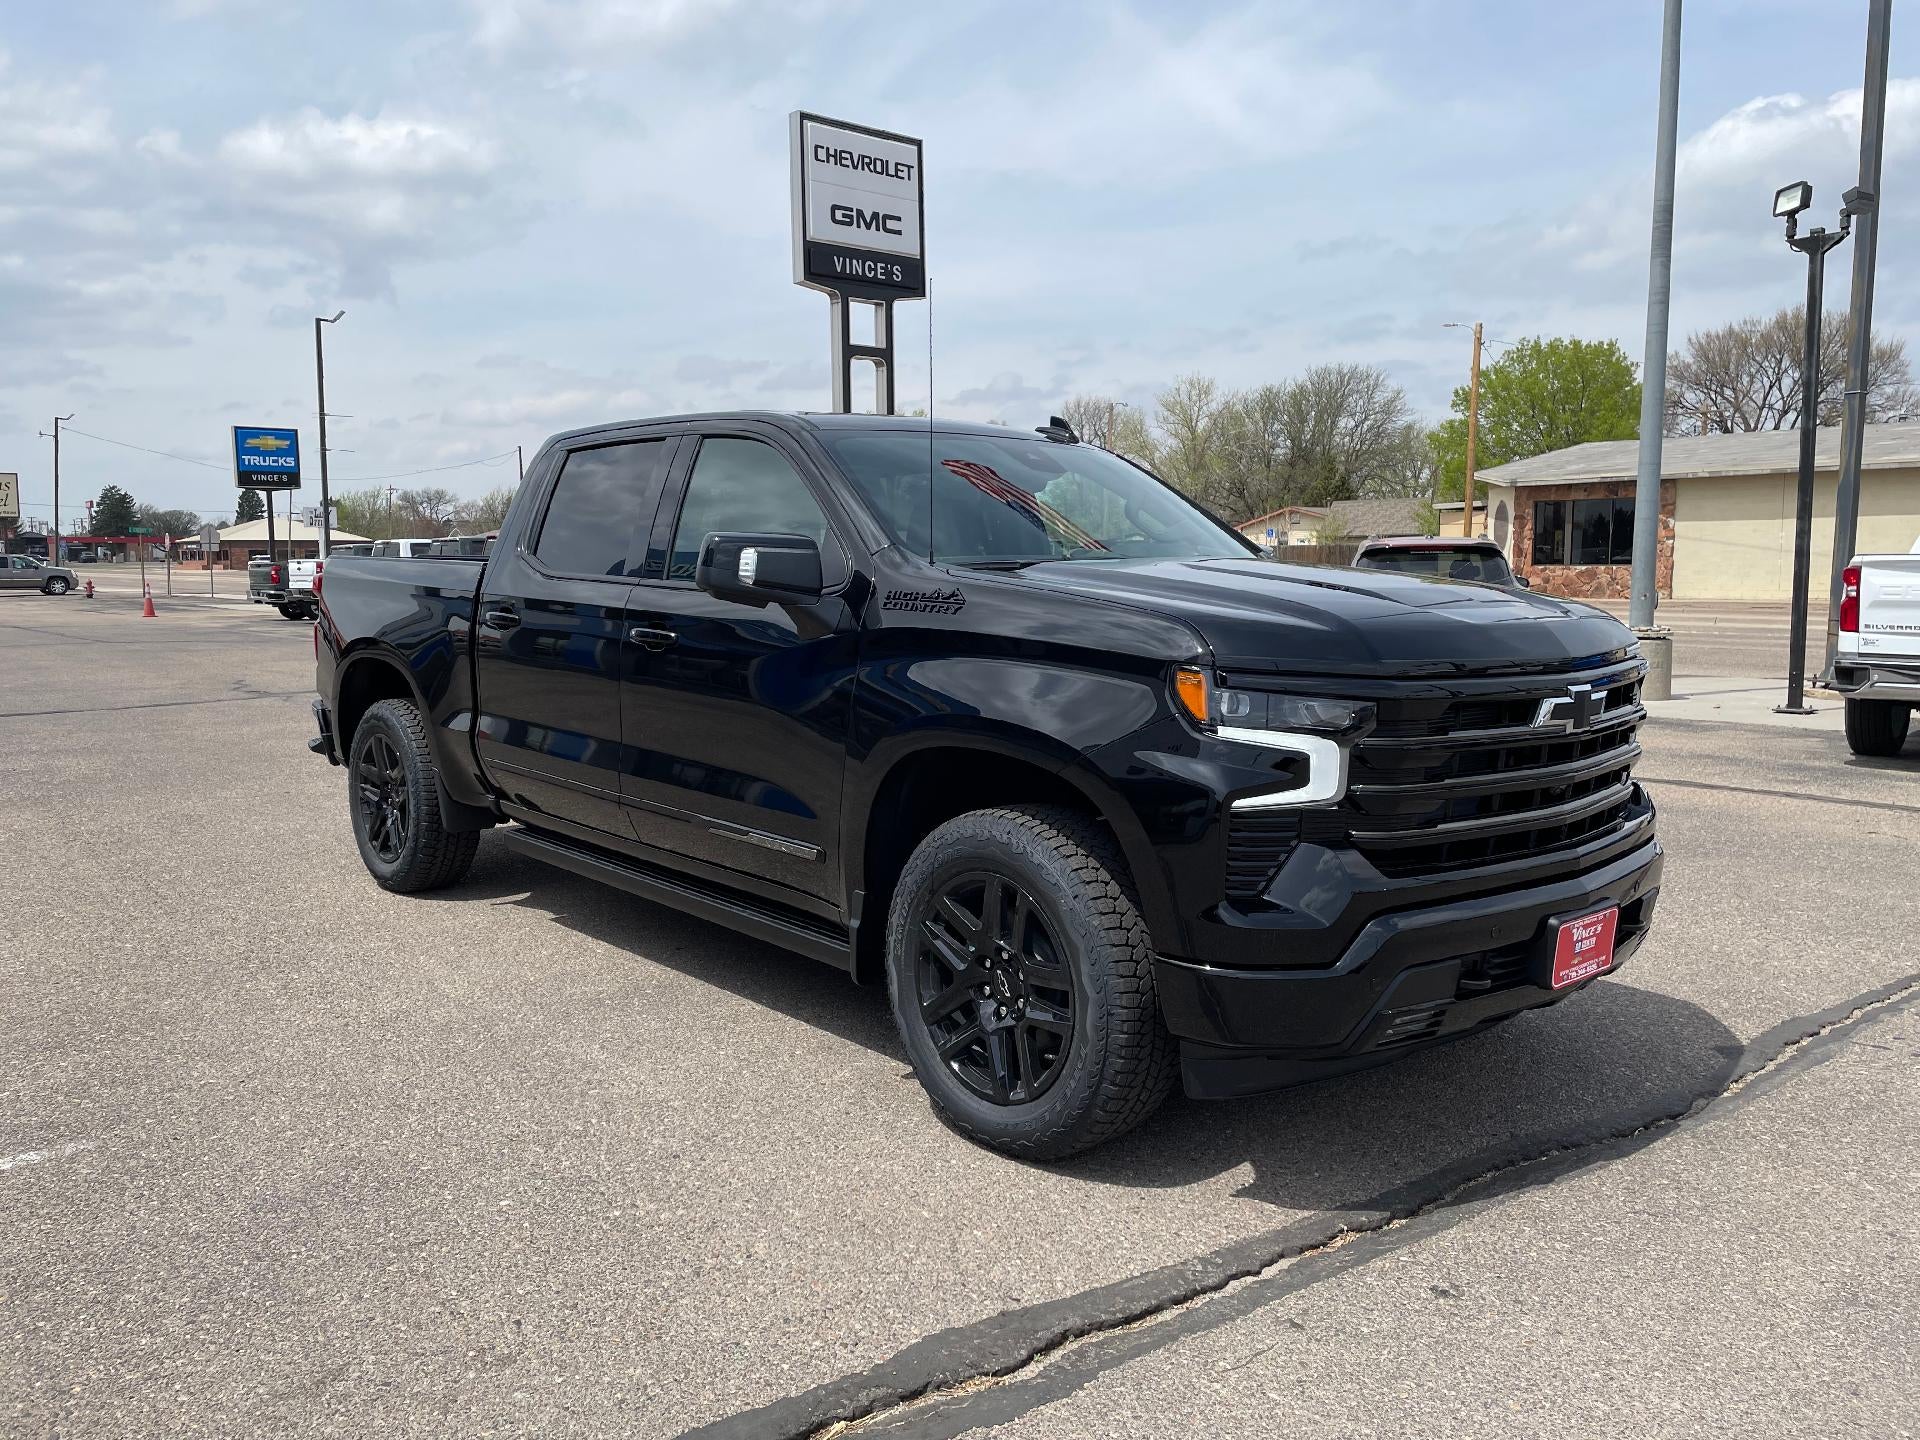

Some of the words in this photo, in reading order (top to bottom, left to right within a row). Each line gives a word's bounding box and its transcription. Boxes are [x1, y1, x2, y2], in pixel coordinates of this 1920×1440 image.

[813, 143, 915, 182] CHEVROLET
[830, 203, 903, 236] GMC
[833, 255, 902, 282] VINCE'S
[241, 455, 295, 467] TRUCKS
[251, 474, 288, 482] VINCE'S
[882, 600, 964, 615] COUNTRY
